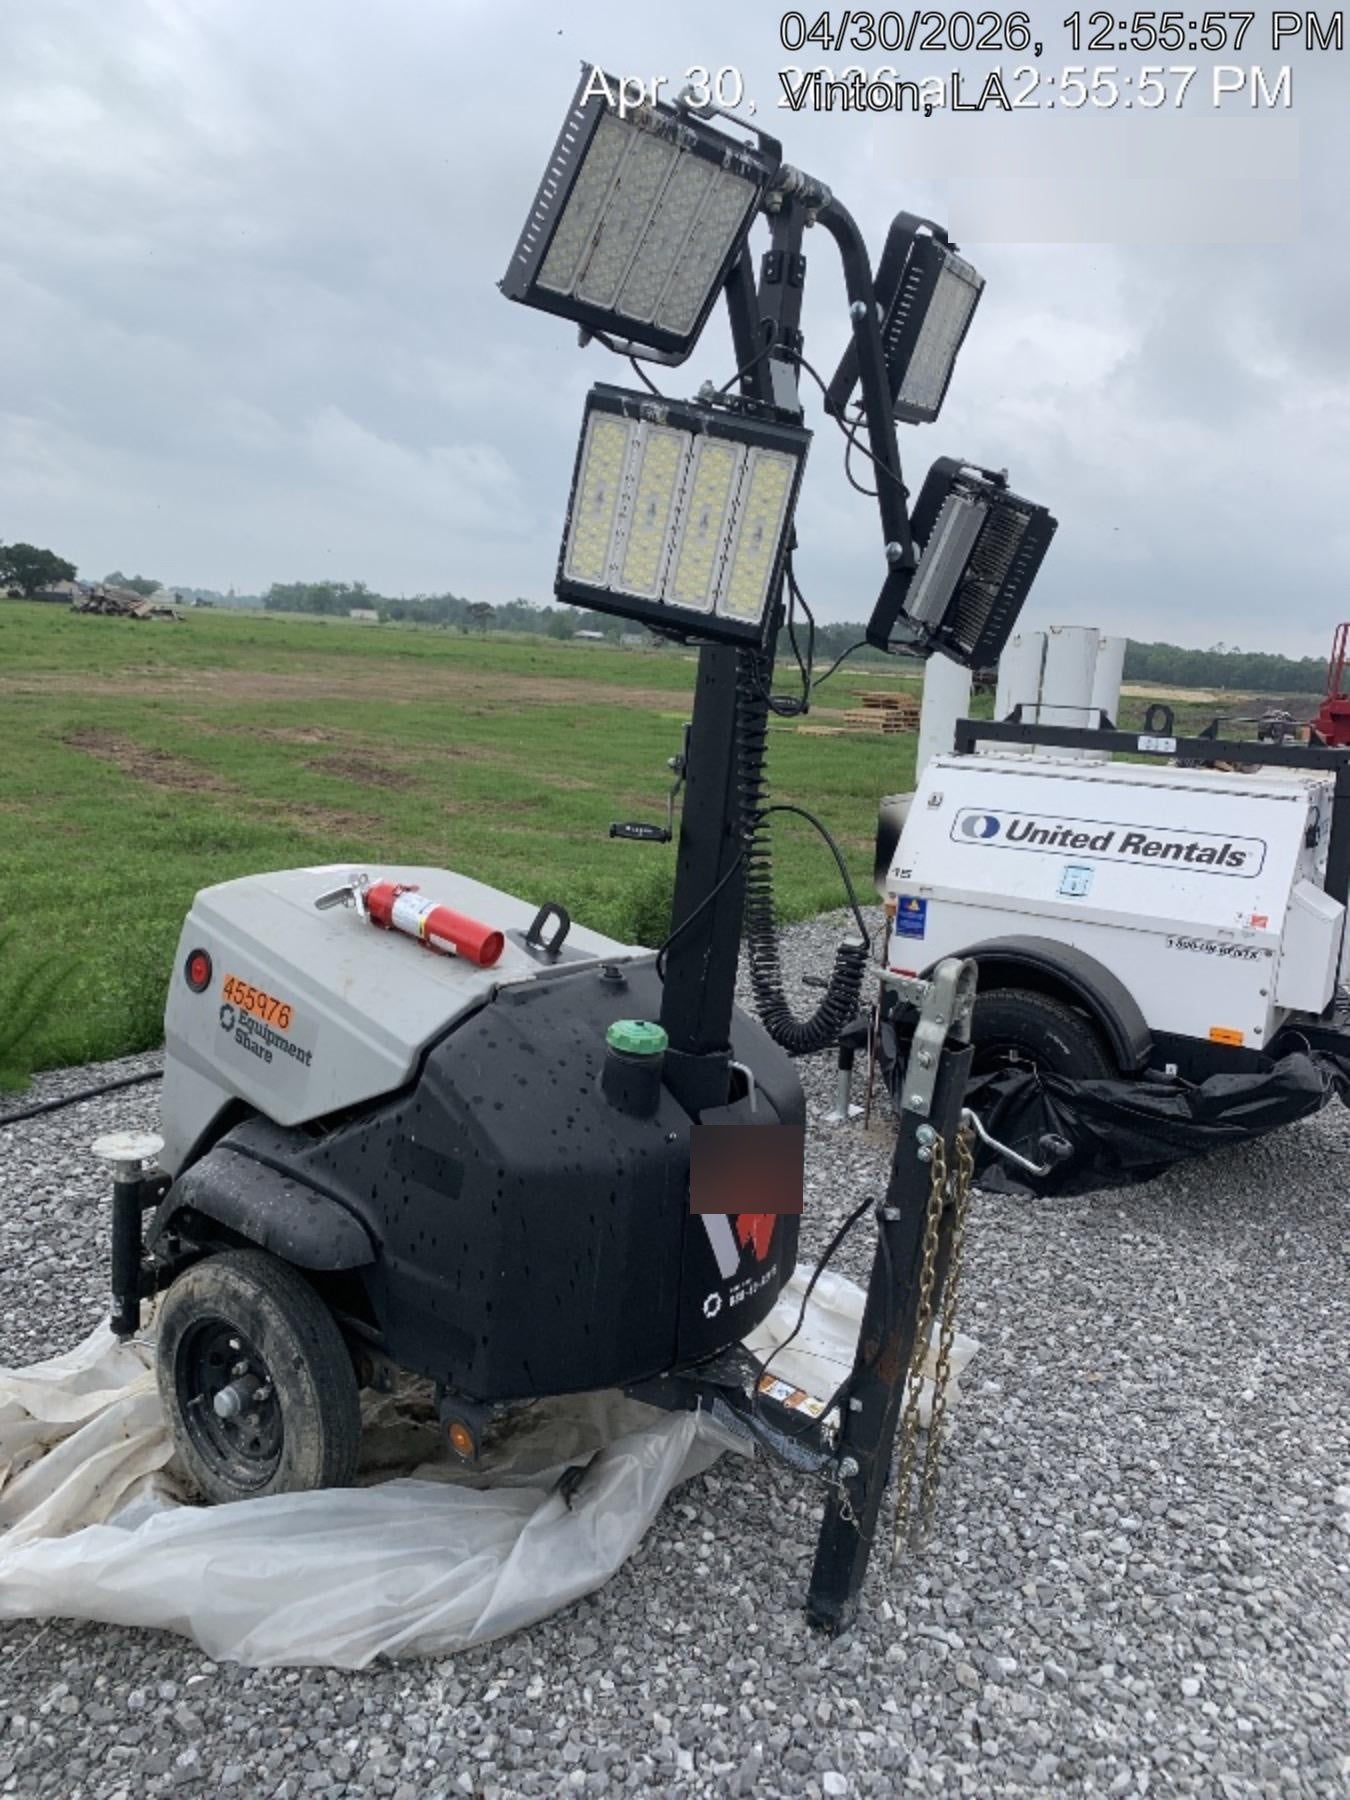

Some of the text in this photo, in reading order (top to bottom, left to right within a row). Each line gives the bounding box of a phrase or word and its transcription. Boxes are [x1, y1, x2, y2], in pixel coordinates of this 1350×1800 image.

[1005, 818, 1247, 868] United Rentals
[223, 977, 291, 1029] 455976
[234, 1026, 273, 1065] Share
[238, 1007, 313, 1068] Equipment
